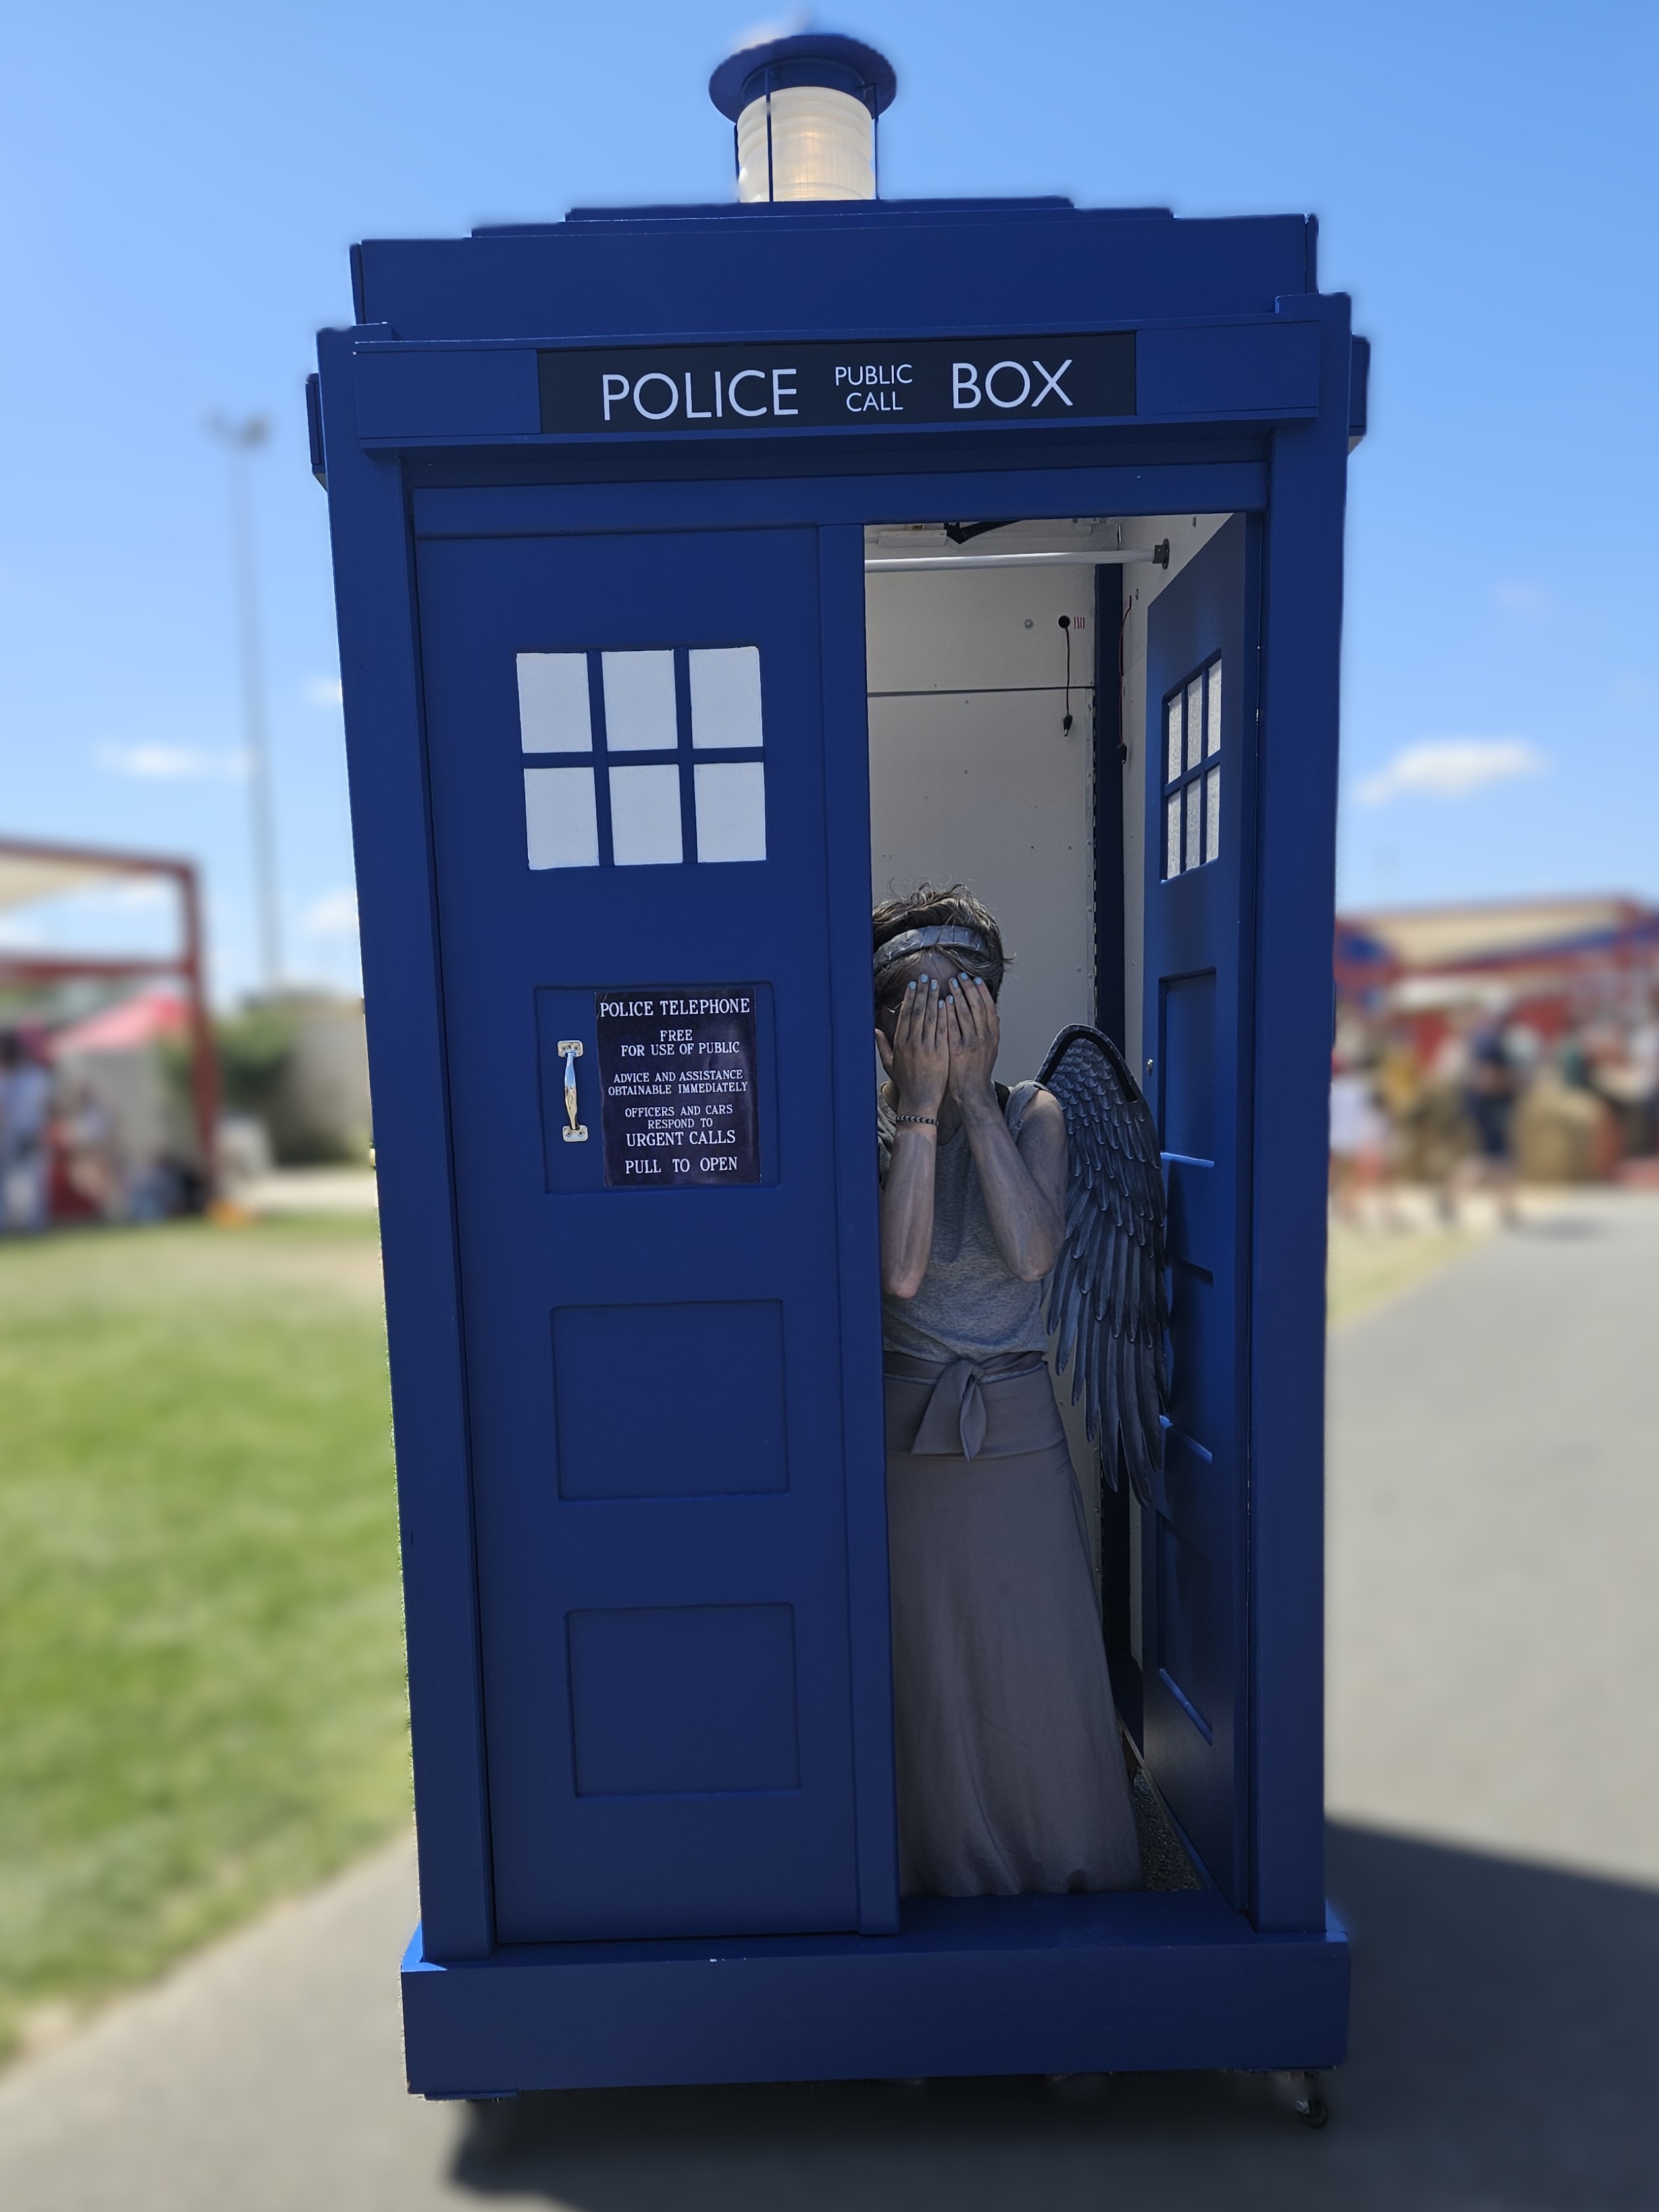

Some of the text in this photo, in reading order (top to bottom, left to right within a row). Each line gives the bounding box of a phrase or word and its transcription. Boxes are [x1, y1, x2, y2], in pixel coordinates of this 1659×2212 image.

[835, 364, 913, 386] PUBLIC
[952, 359, 1073, 409] BOX
[602, 368, 798, 421] POLICE
[846, 391, 904, 413] CALL
[600, 998, 750, 1017] POLICE TELEPHONE
[660, 1030, 692, 1042] FREE
[621, 1042, 740, 1056] FOR USE OF PUBLIC
[613, 1070, 742, 1083] ADVICE AND ASSISTANCE
[608, 1082, 748, 1095] OBTAINABLE IMMEDIATELY
[625, 1104, 733, 1118] OFFICERS AND CARS
[648, 1118, 713, 1129] RESPOND TO
[626, 1130, 736, 1146] URGENT CALLS
[625, 1157, 737, 1174] PULL TO OPEN
